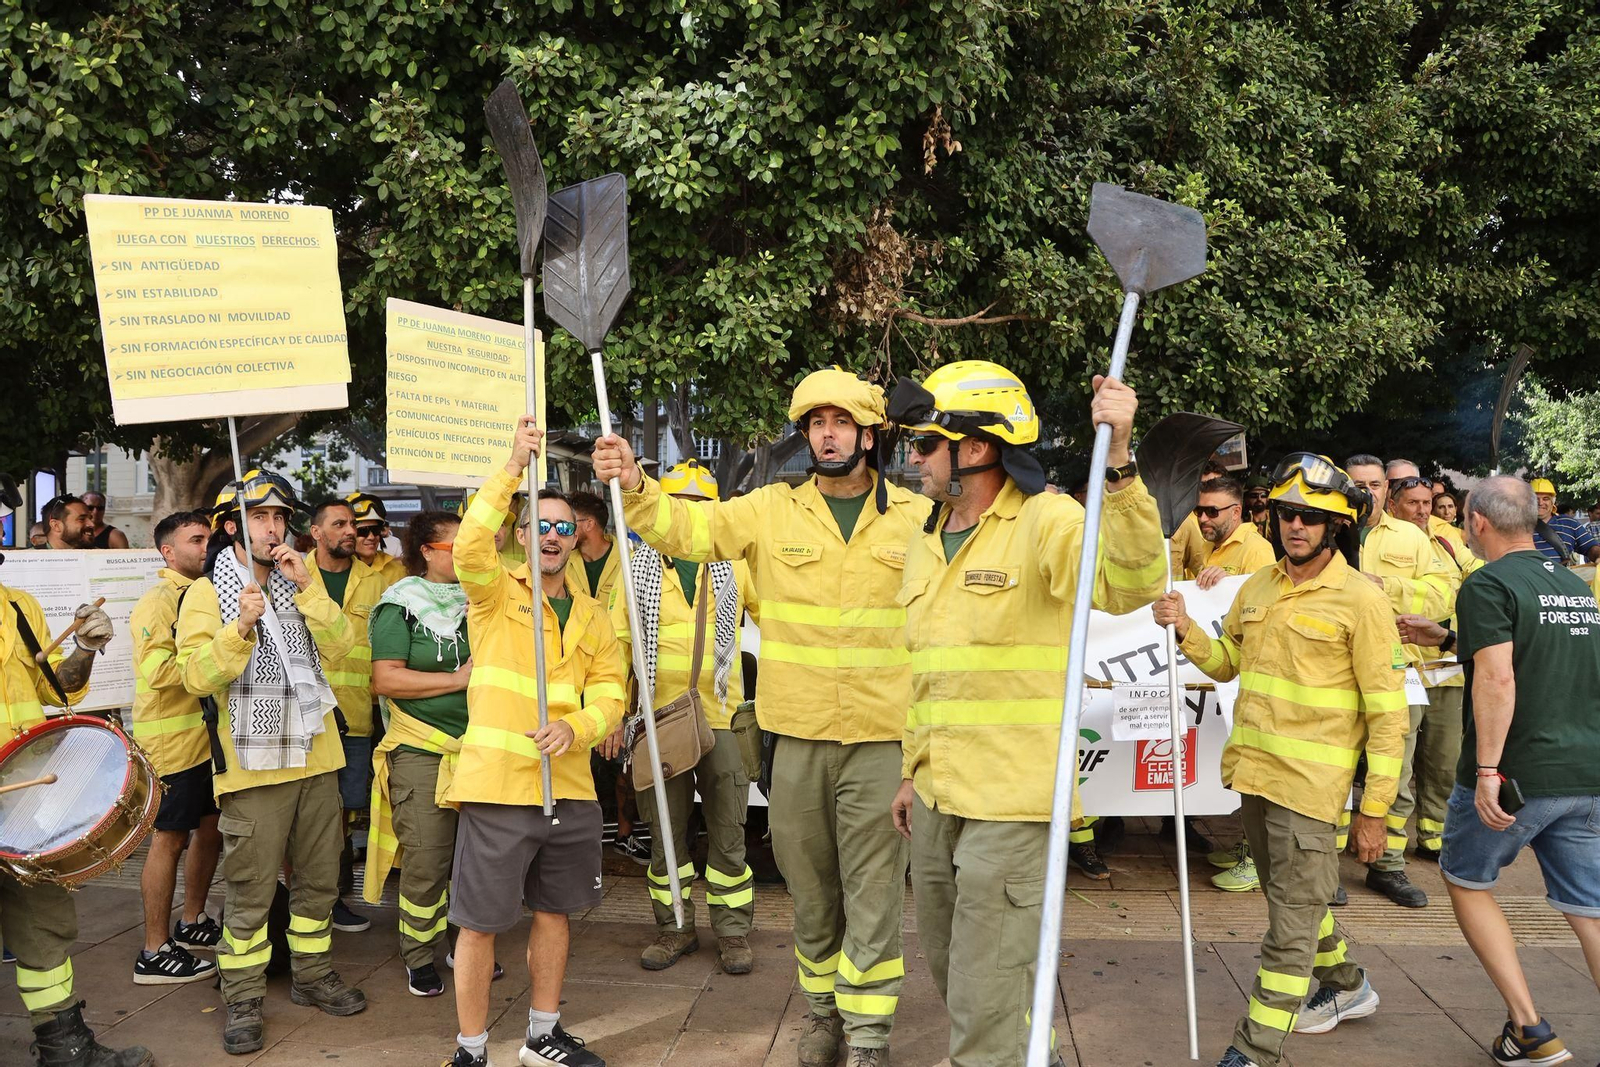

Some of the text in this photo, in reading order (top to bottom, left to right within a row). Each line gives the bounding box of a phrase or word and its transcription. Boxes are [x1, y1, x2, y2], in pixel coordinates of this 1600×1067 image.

[144, 207, 290, 220] PP DE JUANMA MORENO
[116, 234, 320, 247] JUEGA CON NUESTROS DERECHOS:
[111, 259, 220, 271] SIN ANTIGÜEDAD
[116, 287, 218, 299] SIN ESTABILIDAD
[119, 311, 291, 326] SIN TRASLADO NI MOVILIDAD
[397, 316, 408, 326] PP
[410, 319, 420, 329] DE
[421, 321, 456, 336] JUANMA
[458, 328, 492, 342] MORENO
[494, 335, 517, 348] JUEGA
[120, 333, 348, 354] SIN FORMACIÓN ESPECÍFICA Y DE CALIDAD
[427, 340, 511, 363] NUESTRA SEGURIDAD:
[126, 361, 295, 380] SIN NEGOCIACIÓN COLECTIVA
[388, 371, 417, 383] RIESGO
[396, 352, 526, 383] DISPOSITIVO INCOMPLETO EN ALTO
[396, 391, 421, 402] FALTA
[422, 394, 433, 403] DE
[461, 400, 499, 412] MATERIAL
[395, 410, 514, 432] COMUNICACIONES DEFICIENTES
[395, 428, 513, 448] VEHÍCULOS INEFICACES PARA L
[390, 445, 492, 464] EXTINCIÓN DE INCENDIOS
[1570, 628, 1589, 636] 5932
[1143, 721, 1170, 729] ejemplo
